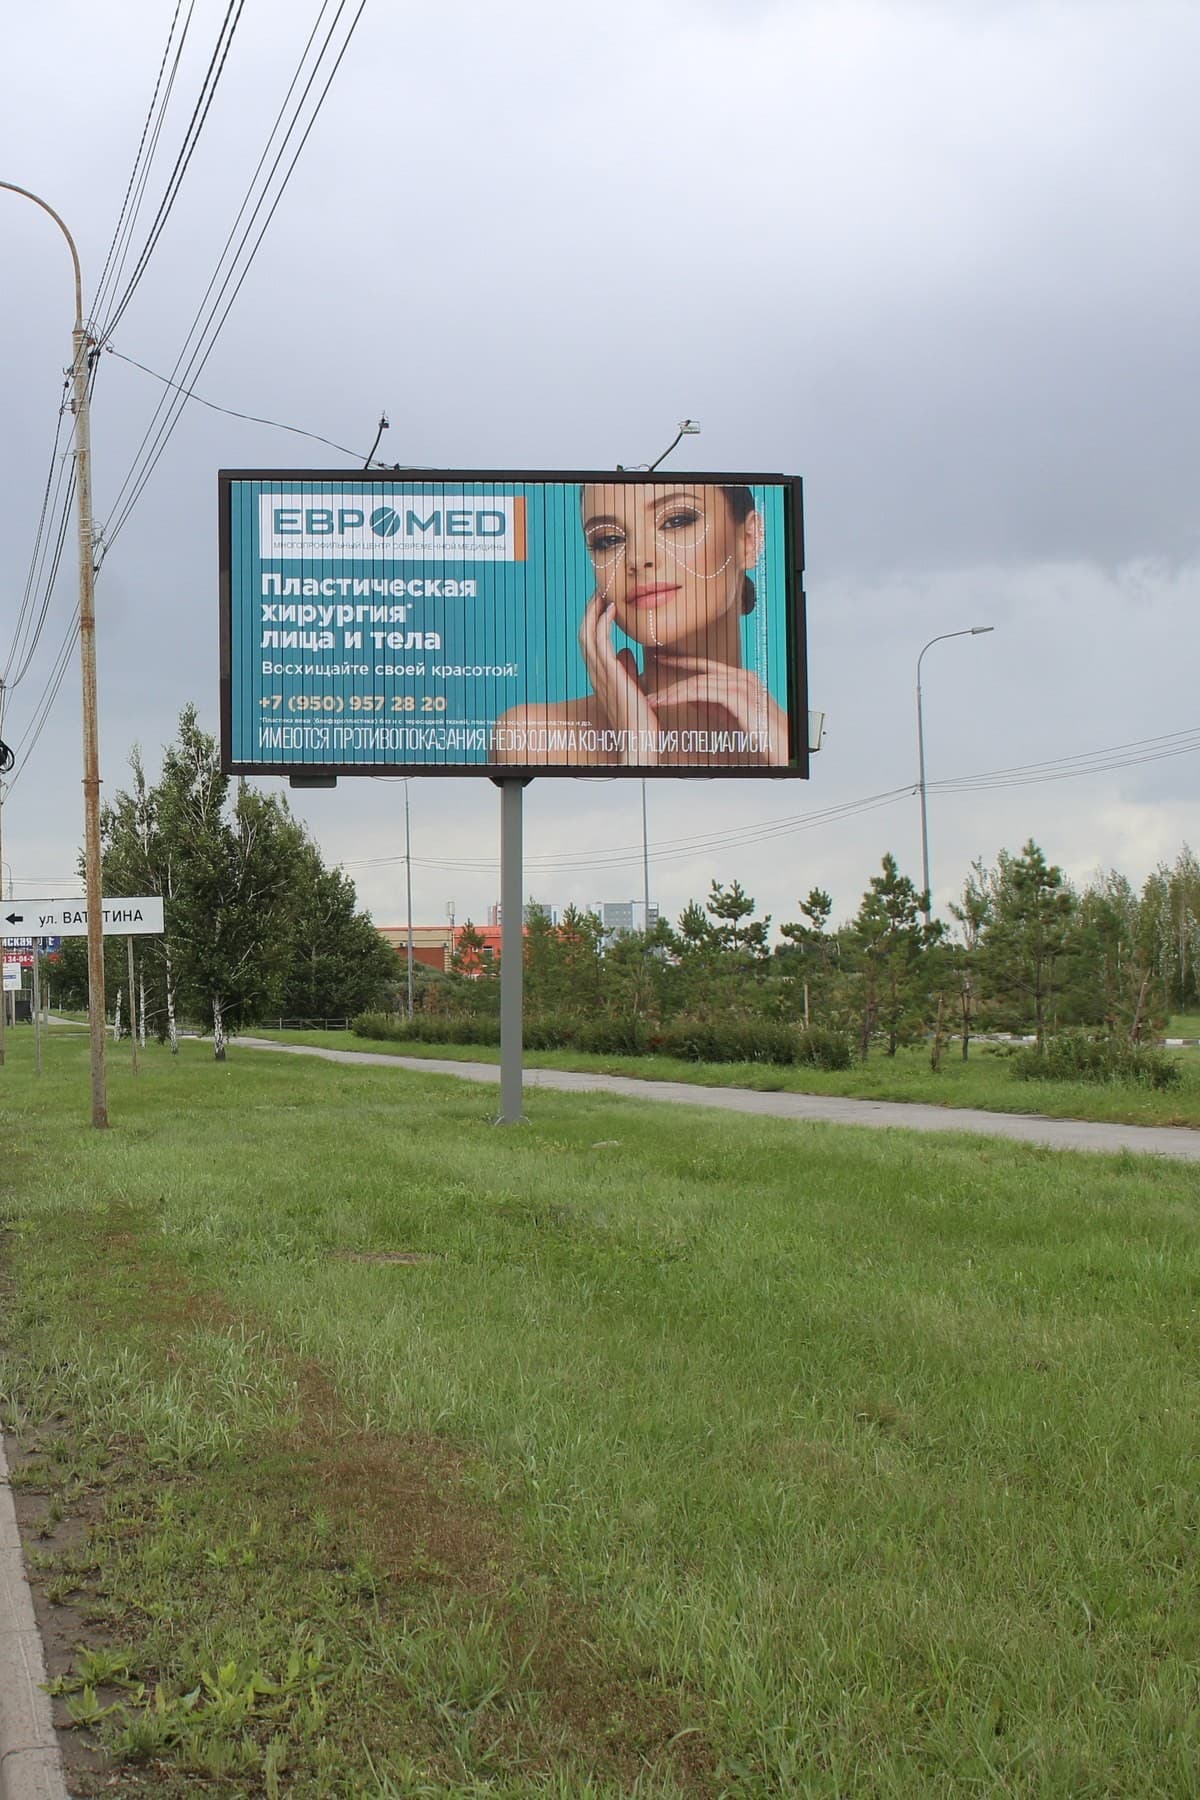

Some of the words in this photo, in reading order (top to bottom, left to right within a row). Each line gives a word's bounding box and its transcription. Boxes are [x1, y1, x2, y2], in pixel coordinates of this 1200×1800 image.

[274, 541, 360, 550] МНОГОПРОФИЛЬНЫЙ
[362, 541, 391, 551] ЦЕНТР
[393, 541, 457, 551] СОВРЕМЕННОЙ
[261, 573, 477, 597] Пластическая
[260, 630, 335, 652] лица
[344, 631, 362, 649] и
[370, 631, 441, 650] тела
[262, 661, 369, 677] Восхищайте
[375, 662, 425, 677] своей
[431, 663, 518, 679] красотой!
[258, 695, 283, 710] +7
[288, 695, 344, 713] (950)
[350, 696, 385, 711] 957
[391, 696, 416, 711] 28
[421, 697, 448, 712] 20
[259, 727, 329, 749] ИМЕЮТСЯ
[490, 728, 577, 752] НЕОБХОДИМА
[579, 729, 678, 754] КОНСУЛЬТАЦИЯ
[681, 730, 773, 754] СПЕЦИАЛИСТА
[39, 915, 57, 928] ул.
[63, 910, 143, 924] ВАТТИНА
